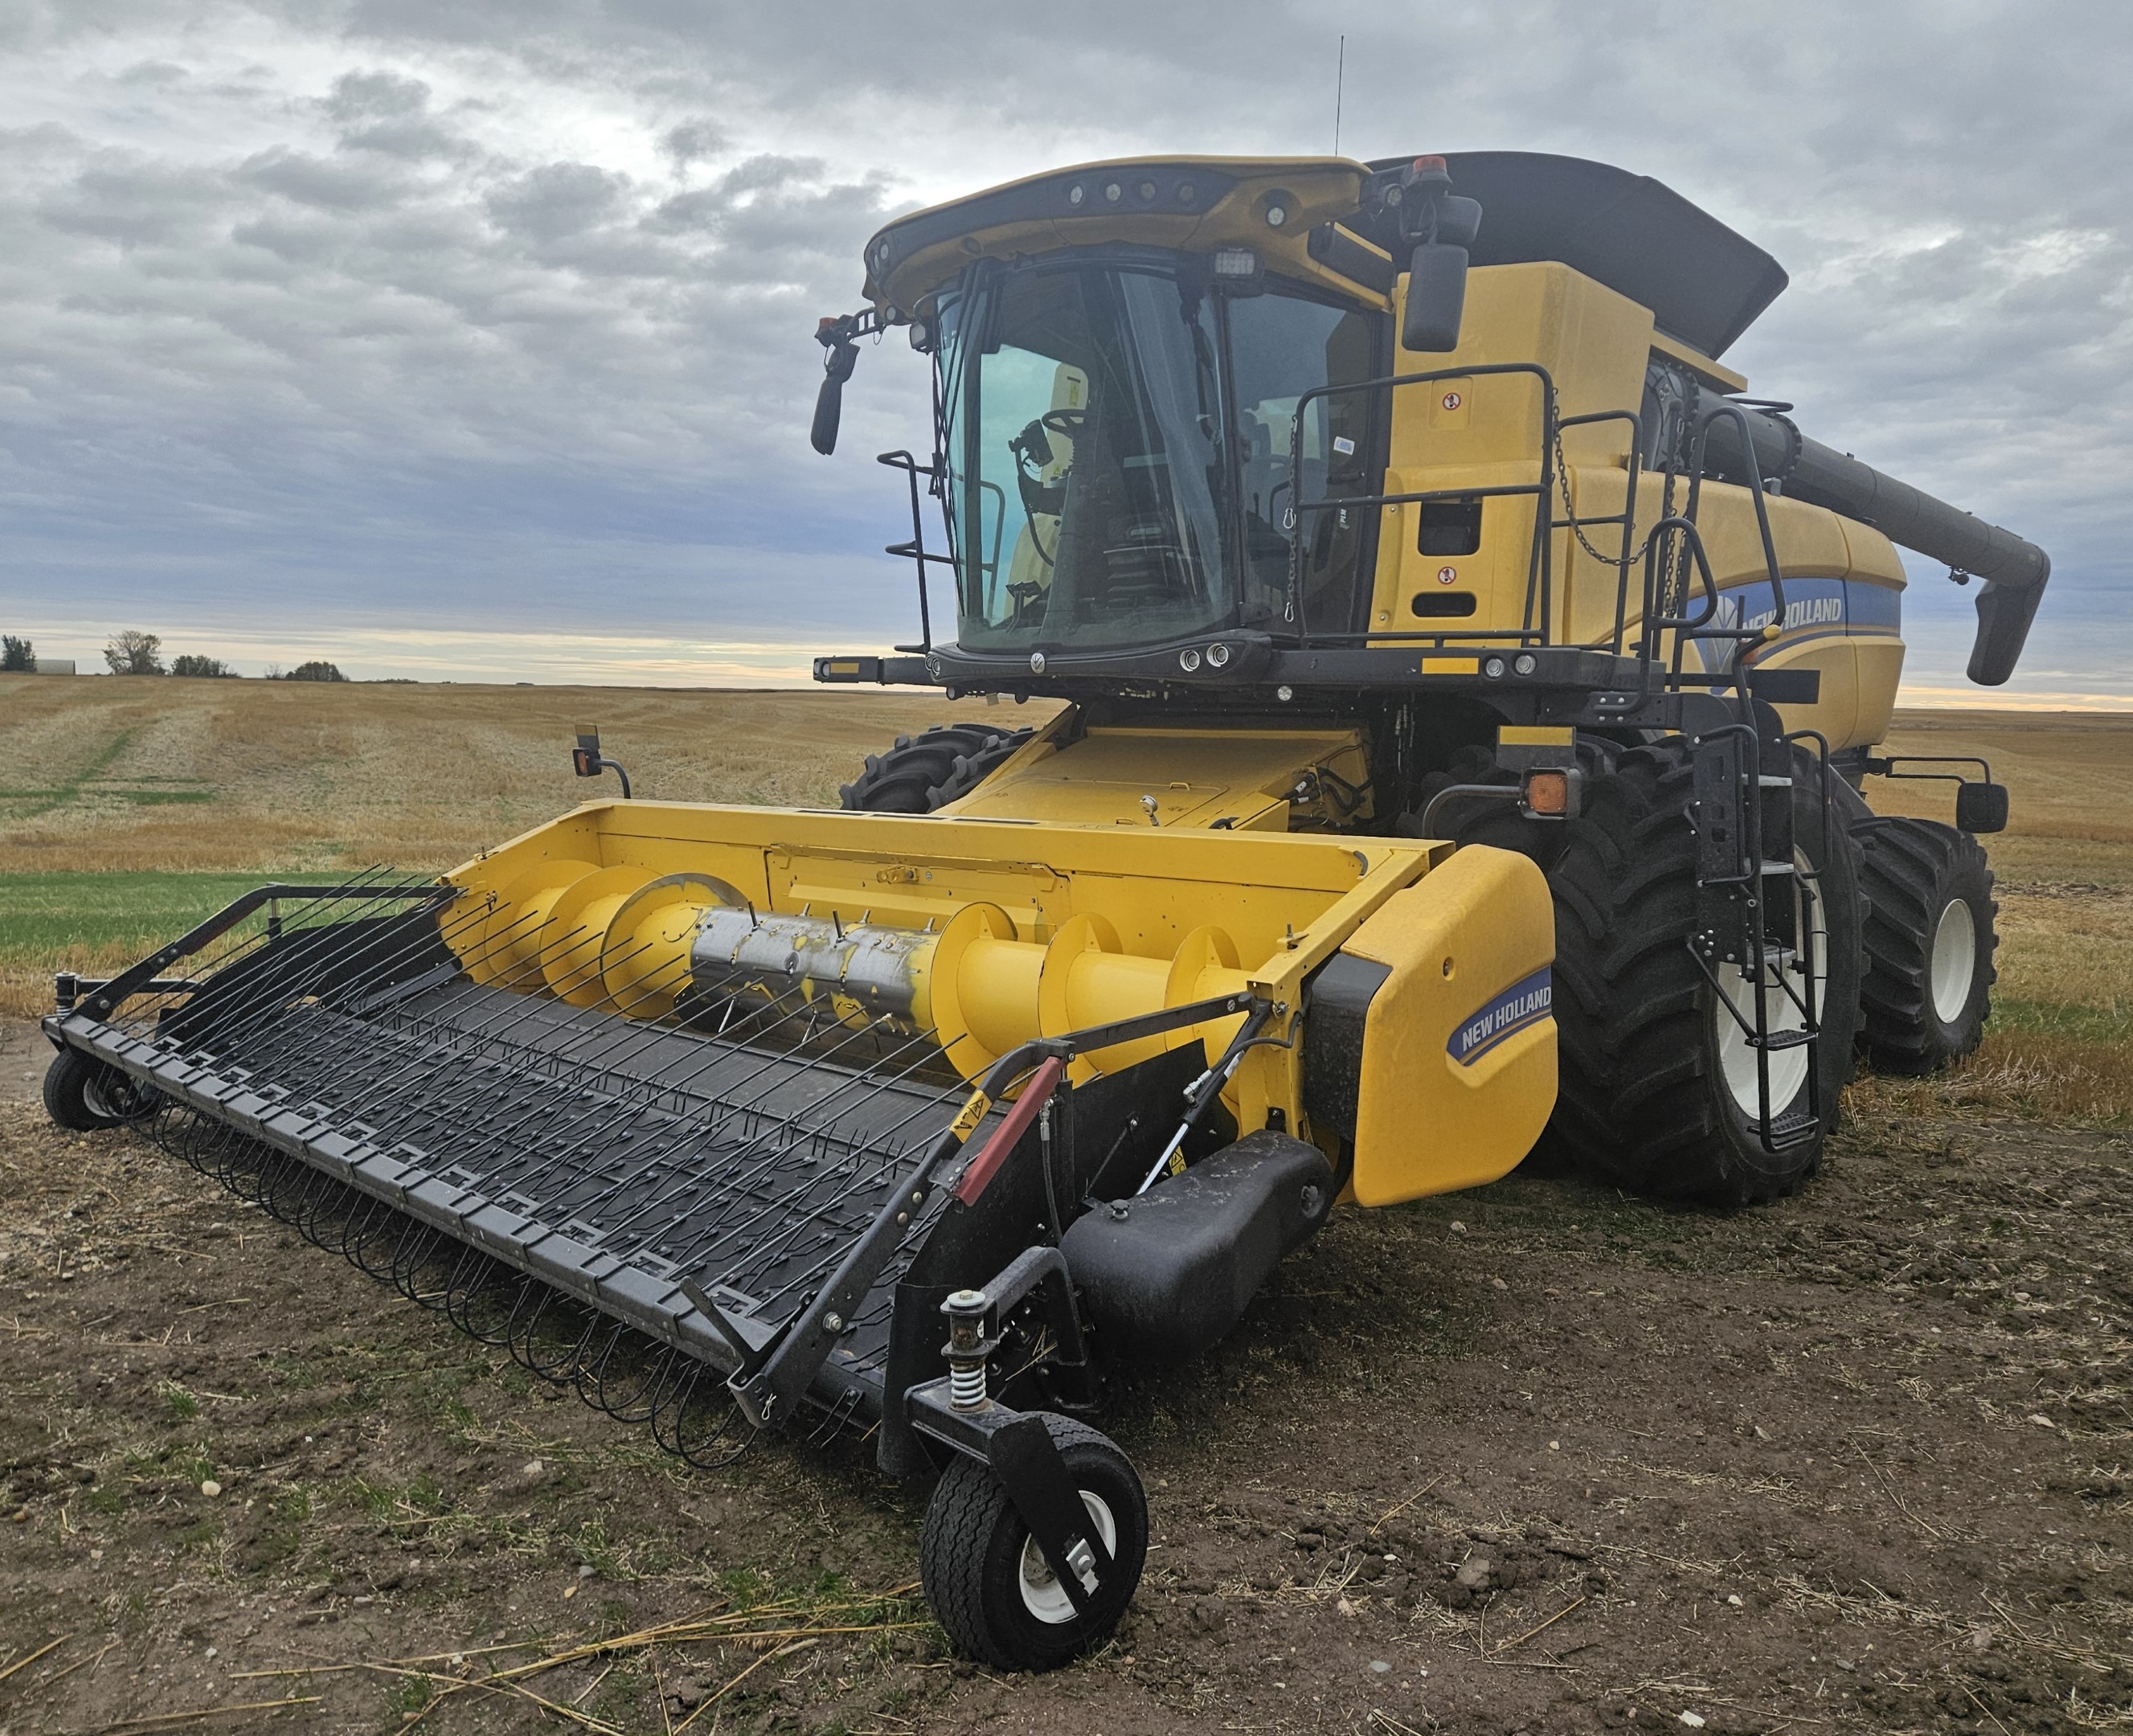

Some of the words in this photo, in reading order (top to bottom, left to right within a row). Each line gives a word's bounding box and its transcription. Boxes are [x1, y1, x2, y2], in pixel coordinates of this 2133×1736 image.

[1781, 598, 1842, 631] HOLLAND
[1462, 1013, 1493, 1052] NEW
[1496, 986, 1552, 1030] HOLLAND
